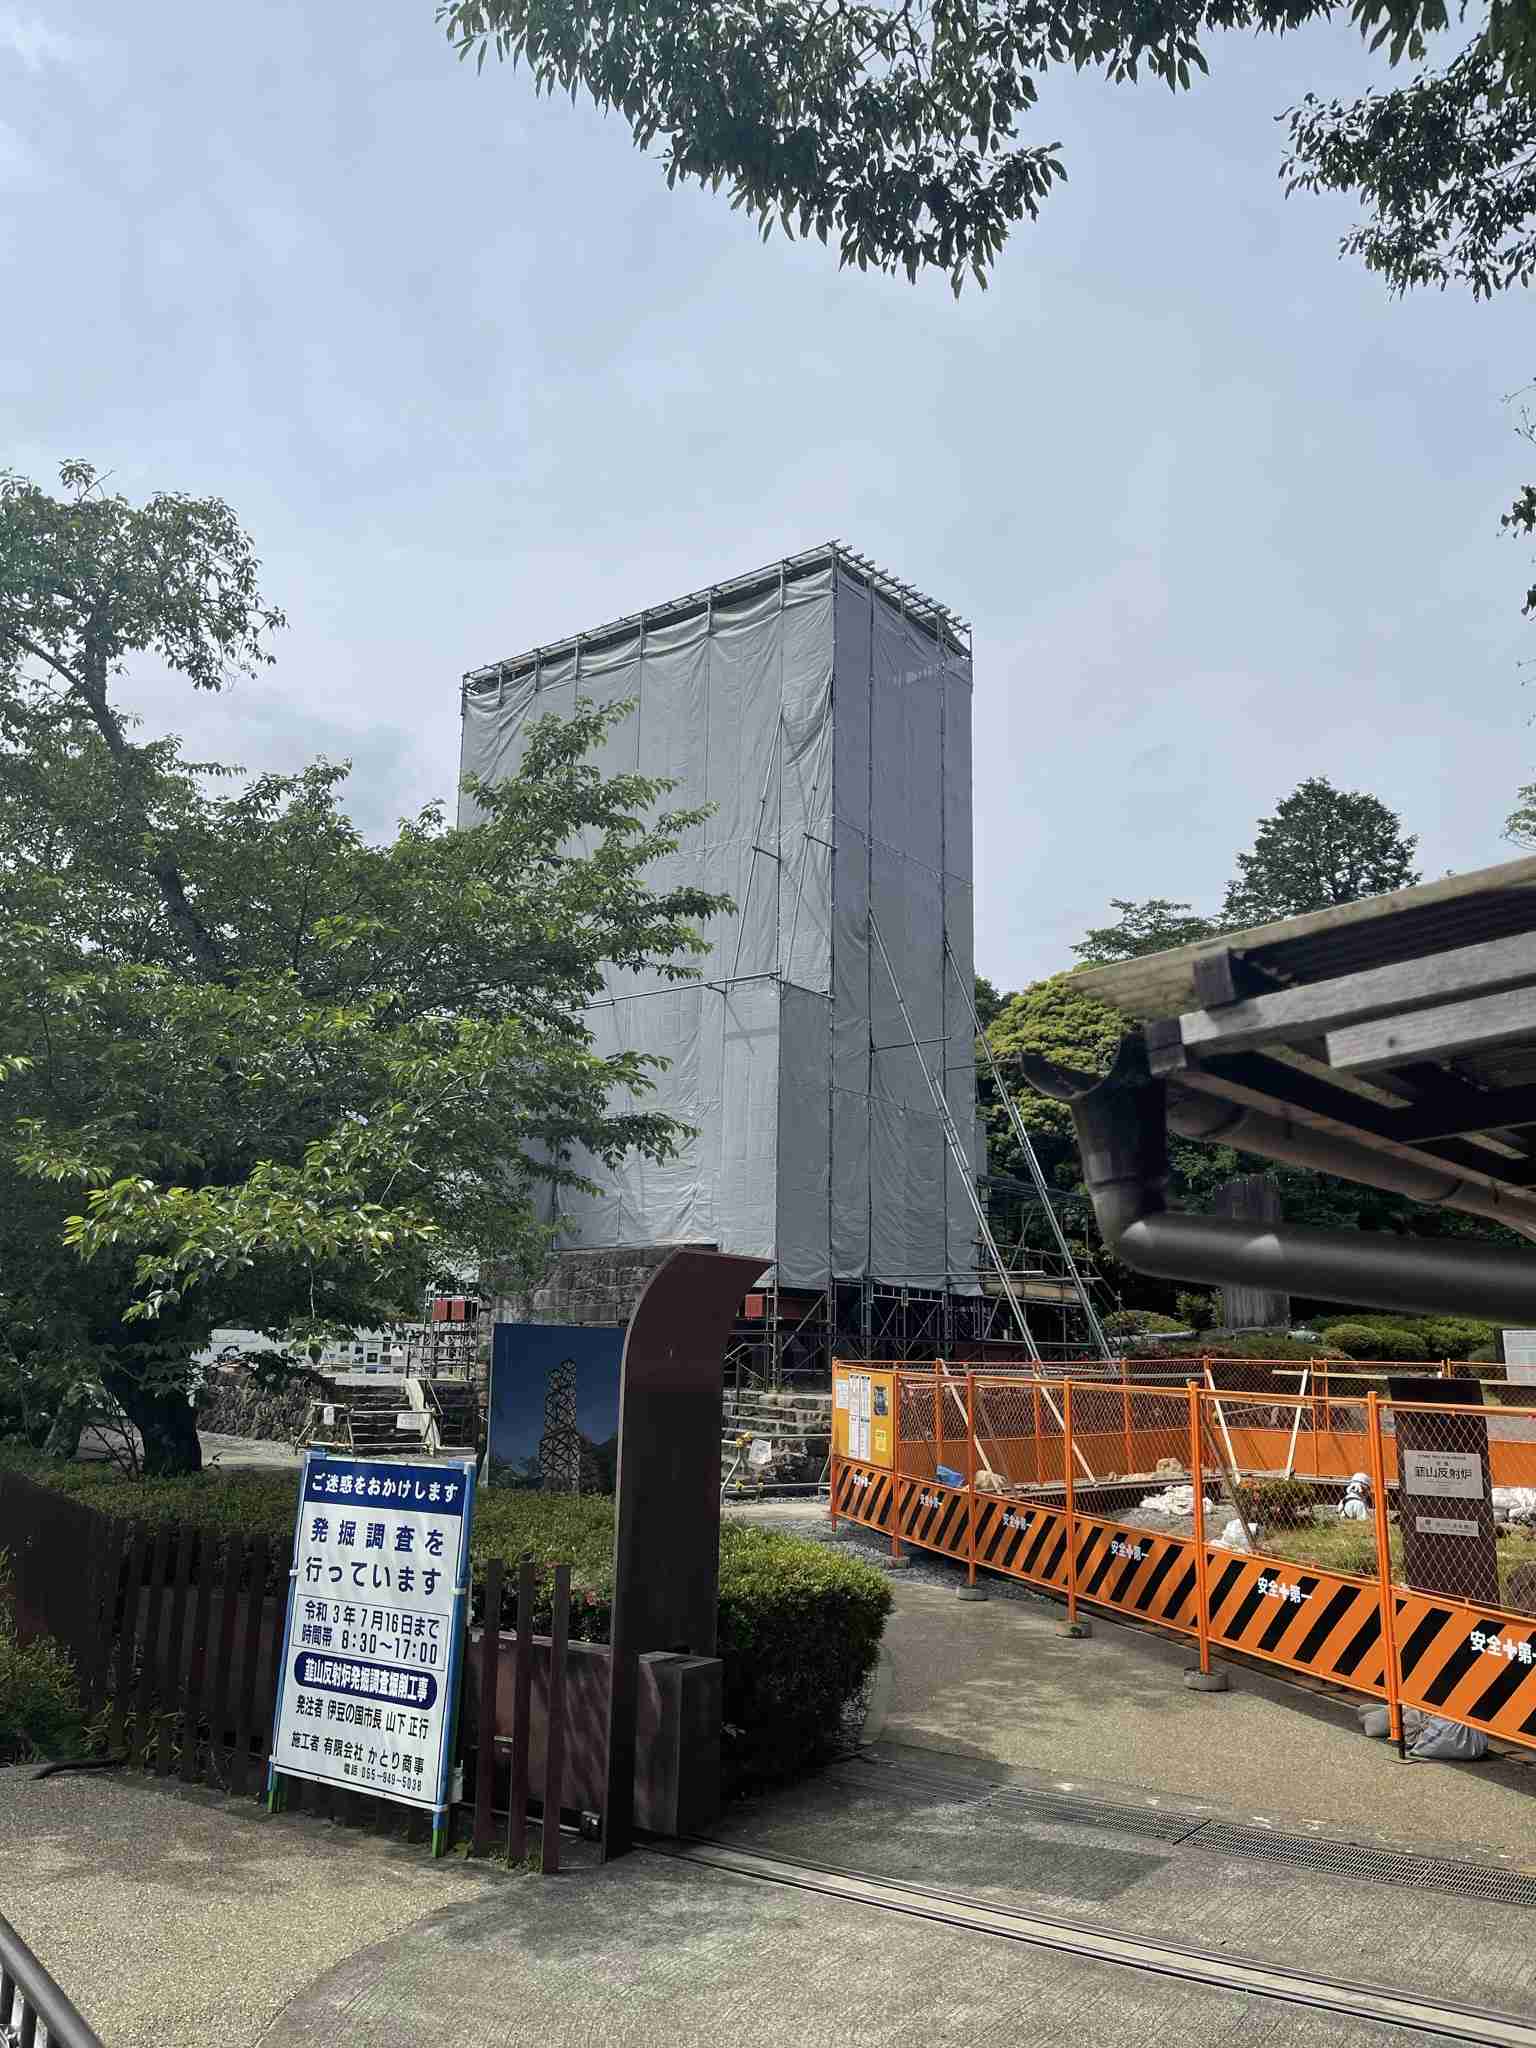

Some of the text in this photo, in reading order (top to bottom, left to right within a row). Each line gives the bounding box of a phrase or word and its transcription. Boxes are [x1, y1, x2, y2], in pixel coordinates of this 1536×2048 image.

[312, 1473, 459, 1502] ご迷惑をおかけします
[310, 1517, 444, 1557] 発掘調査を
[306, 1556, 442, 1595] 行っています
[302, 1623, 333, 1647] 時間帯
[295, 1694, 324, 1720] 発注者
[327, 1699, 383, 1730] 伊豆の国市長
[290, 1730, 425, 1776] 施工者 有限会社 かとり商事
